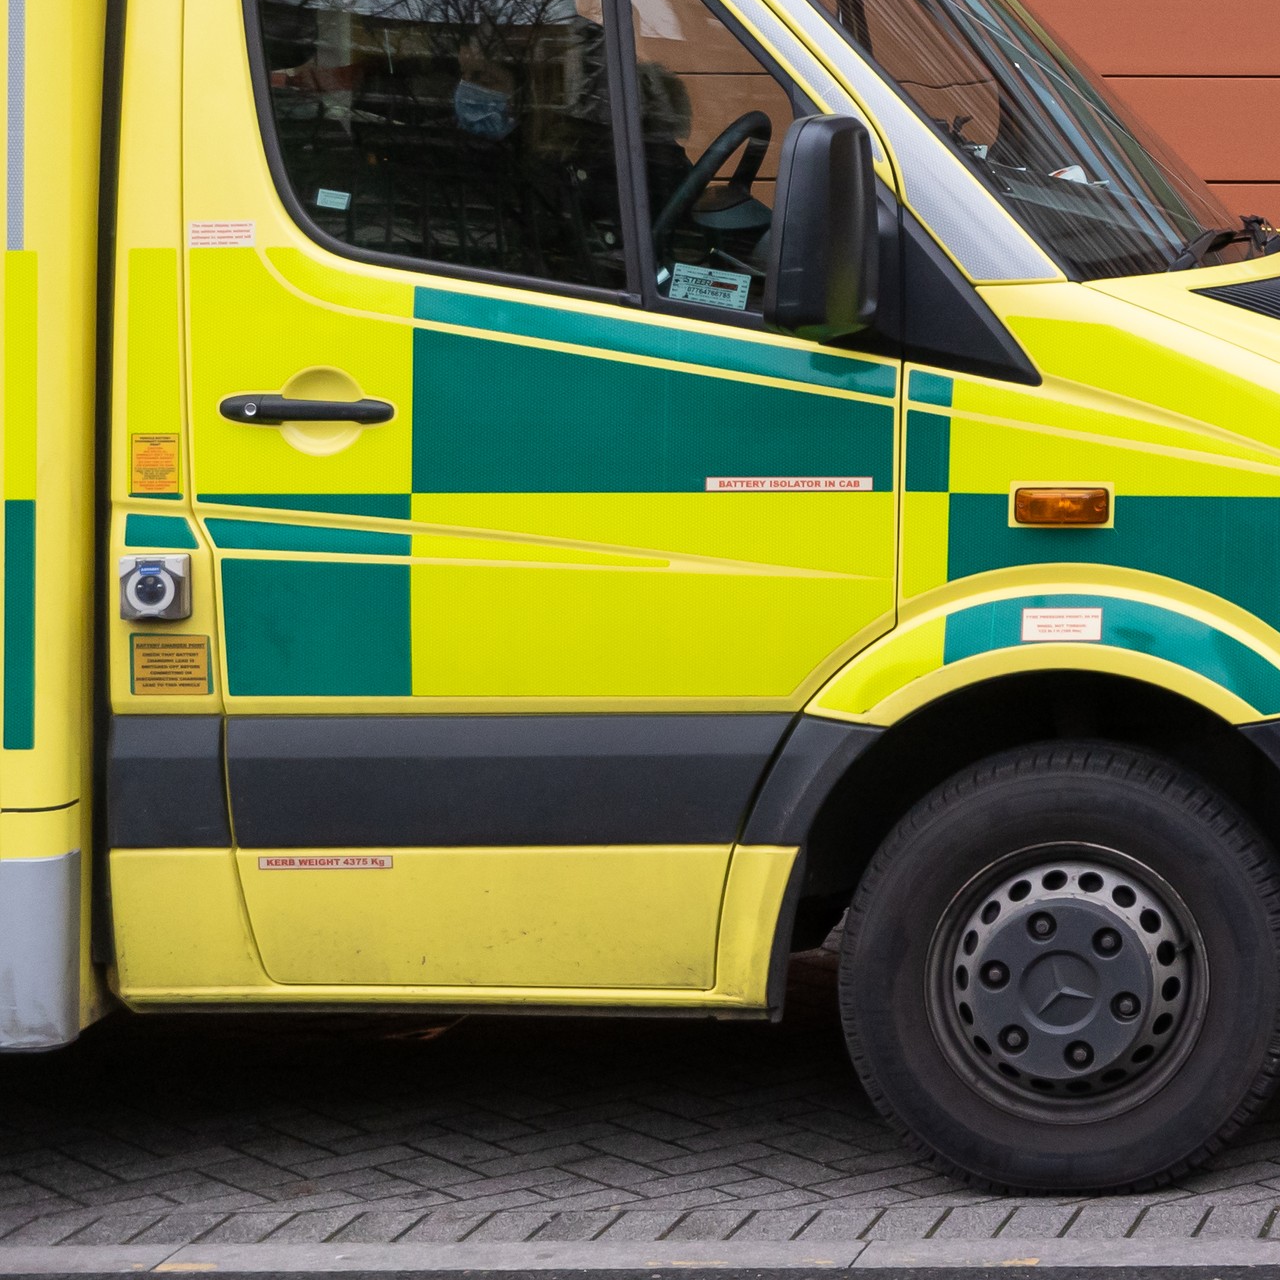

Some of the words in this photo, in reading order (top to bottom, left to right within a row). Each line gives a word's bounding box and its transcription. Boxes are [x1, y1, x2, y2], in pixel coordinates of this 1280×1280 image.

[719, 480, 766, 488] BATTERY
[769, 480, 821, 488] ISOLATOR
[824, 480, 835, 488] IN
[839, 480, 860, 488] CAB
[266, 858, 295, 866] KERB
[298, 858, 340, 866] WEIGHT
[343, 858, 368, 866] 4375
[371, 858, 385, 867] Kg
